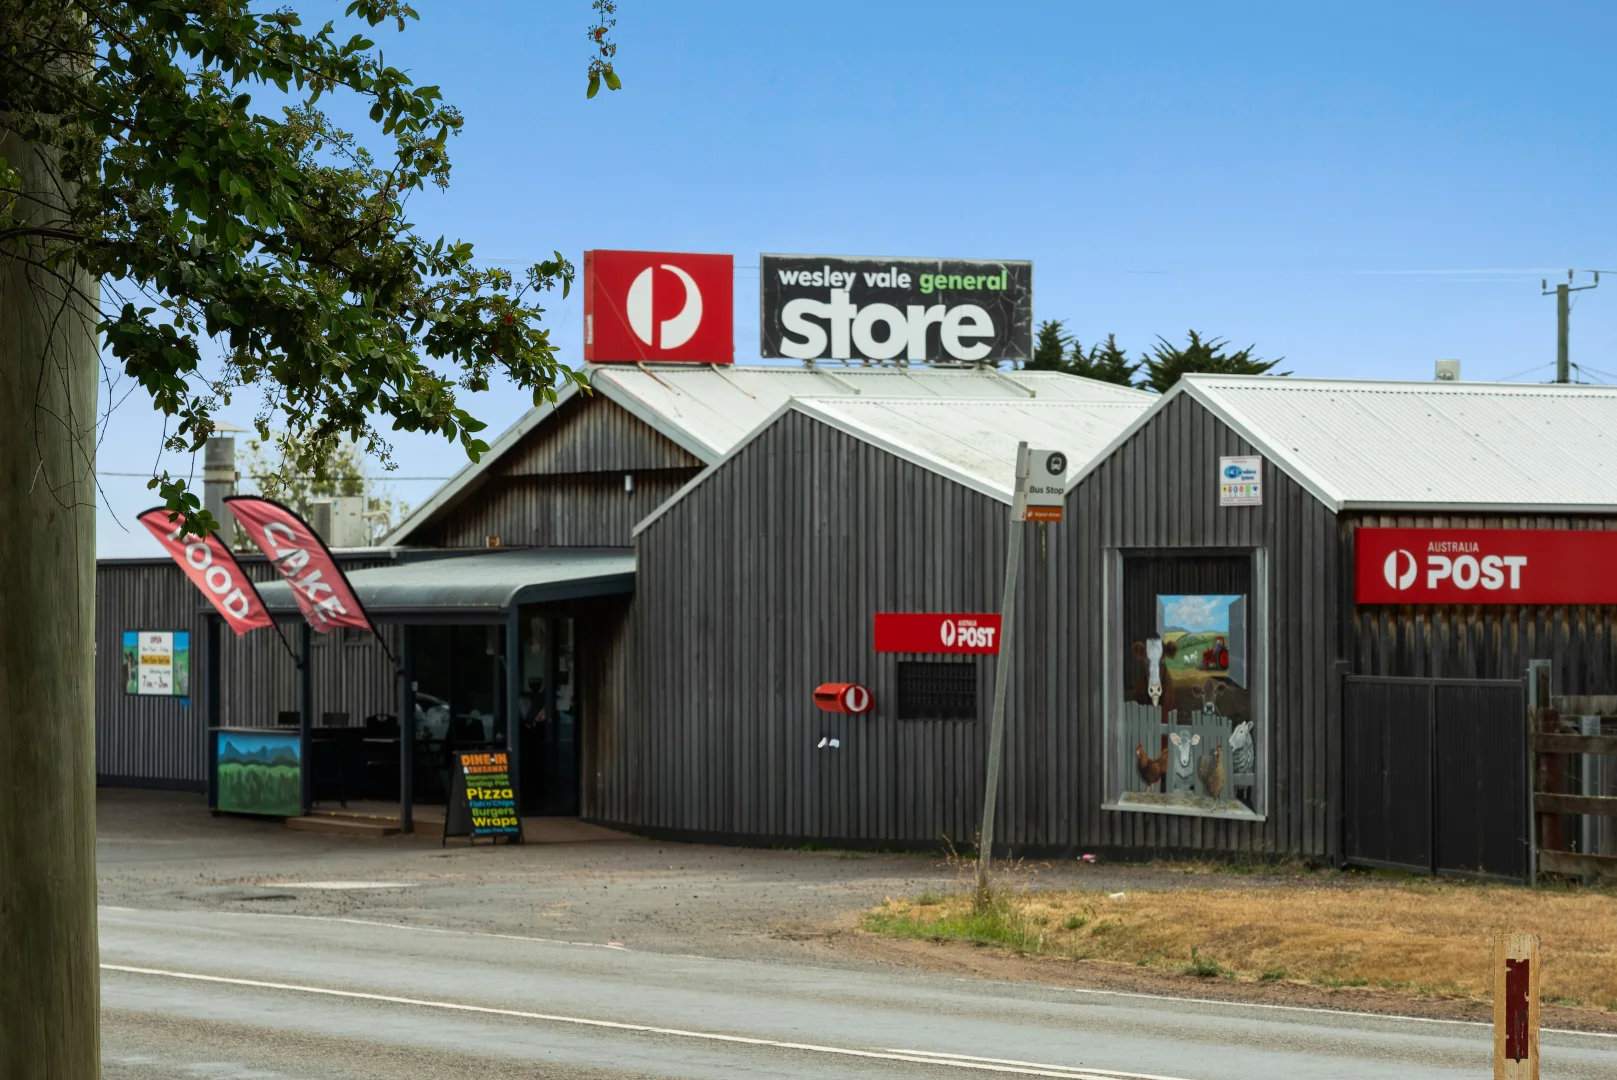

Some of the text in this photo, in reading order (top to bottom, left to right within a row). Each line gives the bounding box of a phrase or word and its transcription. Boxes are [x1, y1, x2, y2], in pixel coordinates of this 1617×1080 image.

[778, 265, 1008, 294] wesley vale general
[780, 288, 995, 361] store
[1029, 486, 1064, 495] Bus Stop
[1427, 541, 1480, 553] AUSTRALIA
[263, 521, 348, 624] CAKE
[1427, 554, 1528, 591] POST
[957, 626, 996, 648] POST
[466, 787, 514, 800] Pizza
[472, 807, 515, 818] Burgers
[472, 817, 518, 828] Wraps
